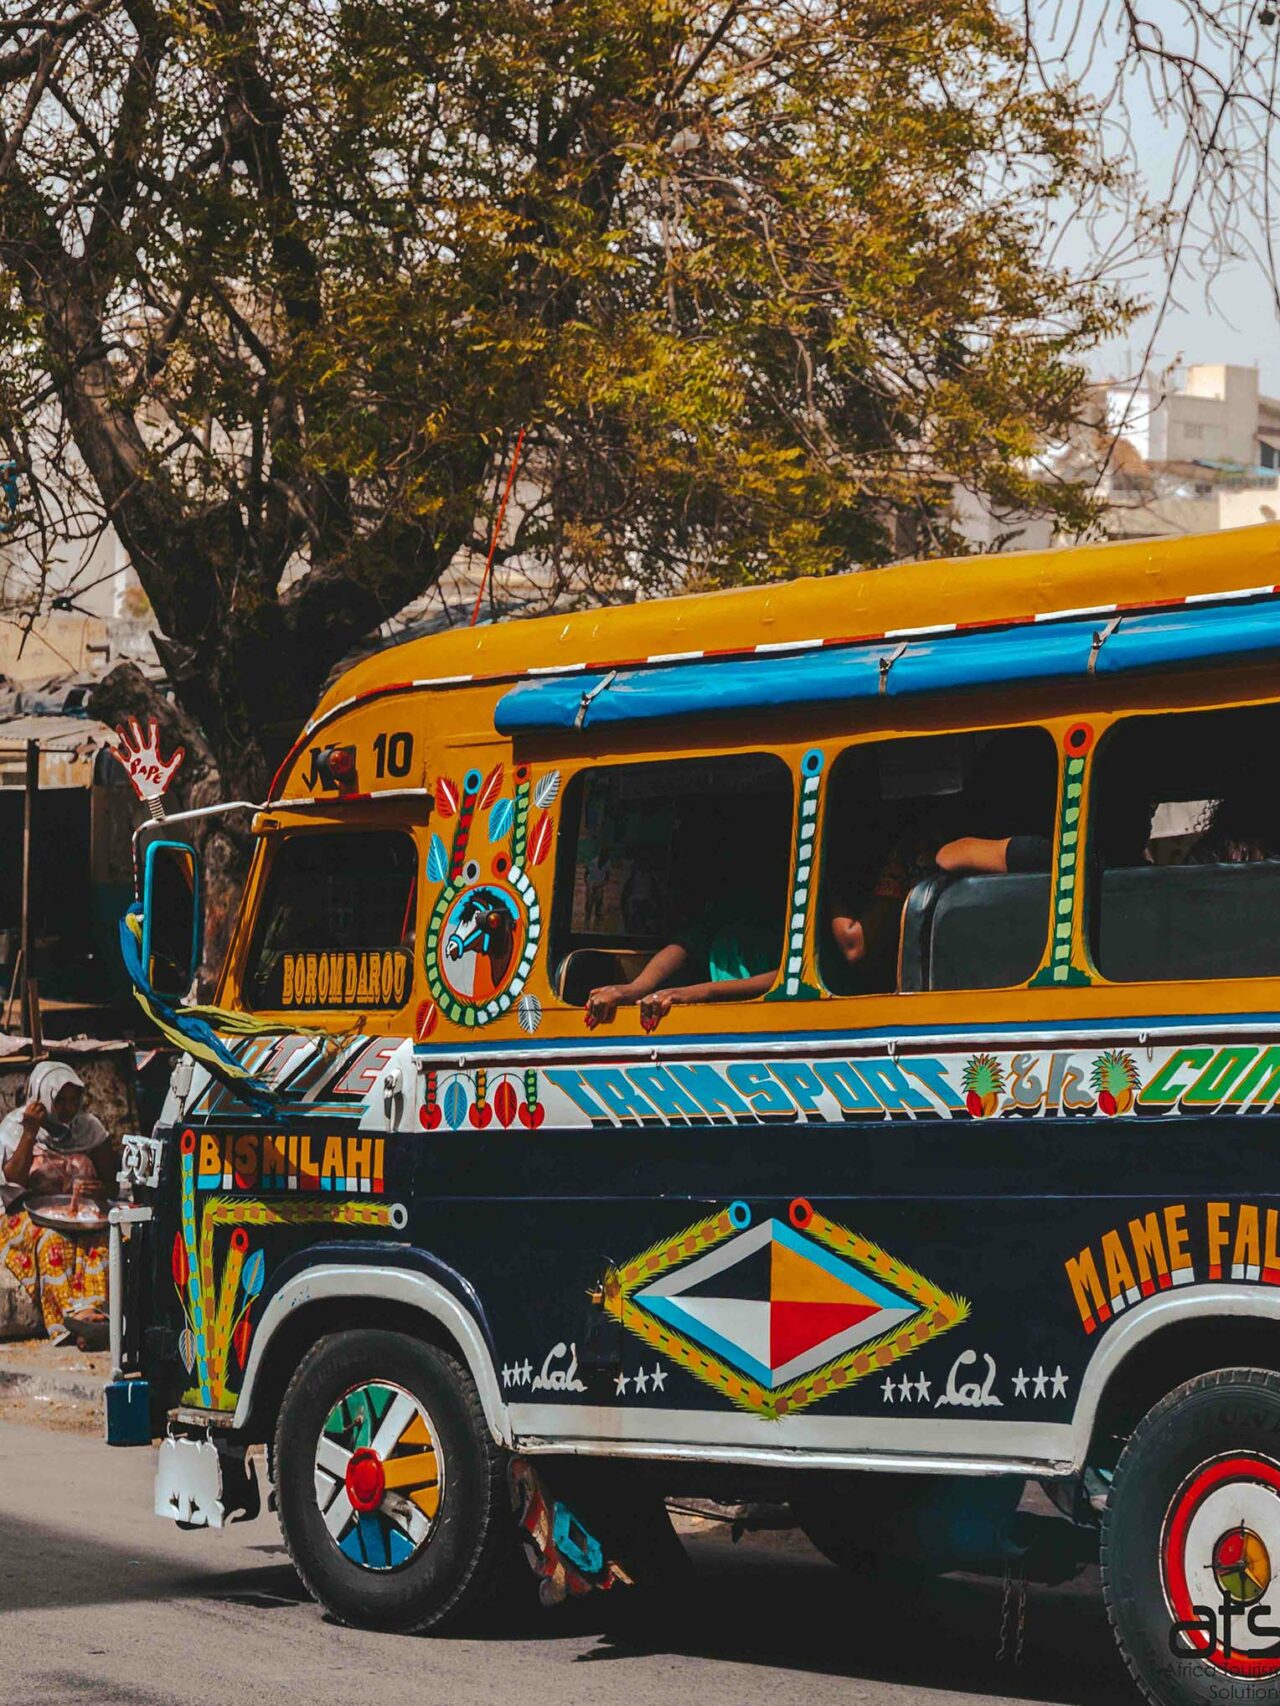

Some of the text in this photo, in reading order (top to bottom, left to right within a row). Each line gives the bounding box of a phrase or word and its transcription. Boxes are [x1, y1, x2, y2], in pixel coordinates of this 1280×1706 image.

[130, 758, 165, 785] PAPE
[373, 732, 413, 779] 10
[282, 952, 406, 1005] BOROM DAROU
[542, 1057, 969, 1122] TRANSPORT
[197, 1133, 385, 1194] BISMILAHI
[1065, 1203, 1195, 1335] MAME
